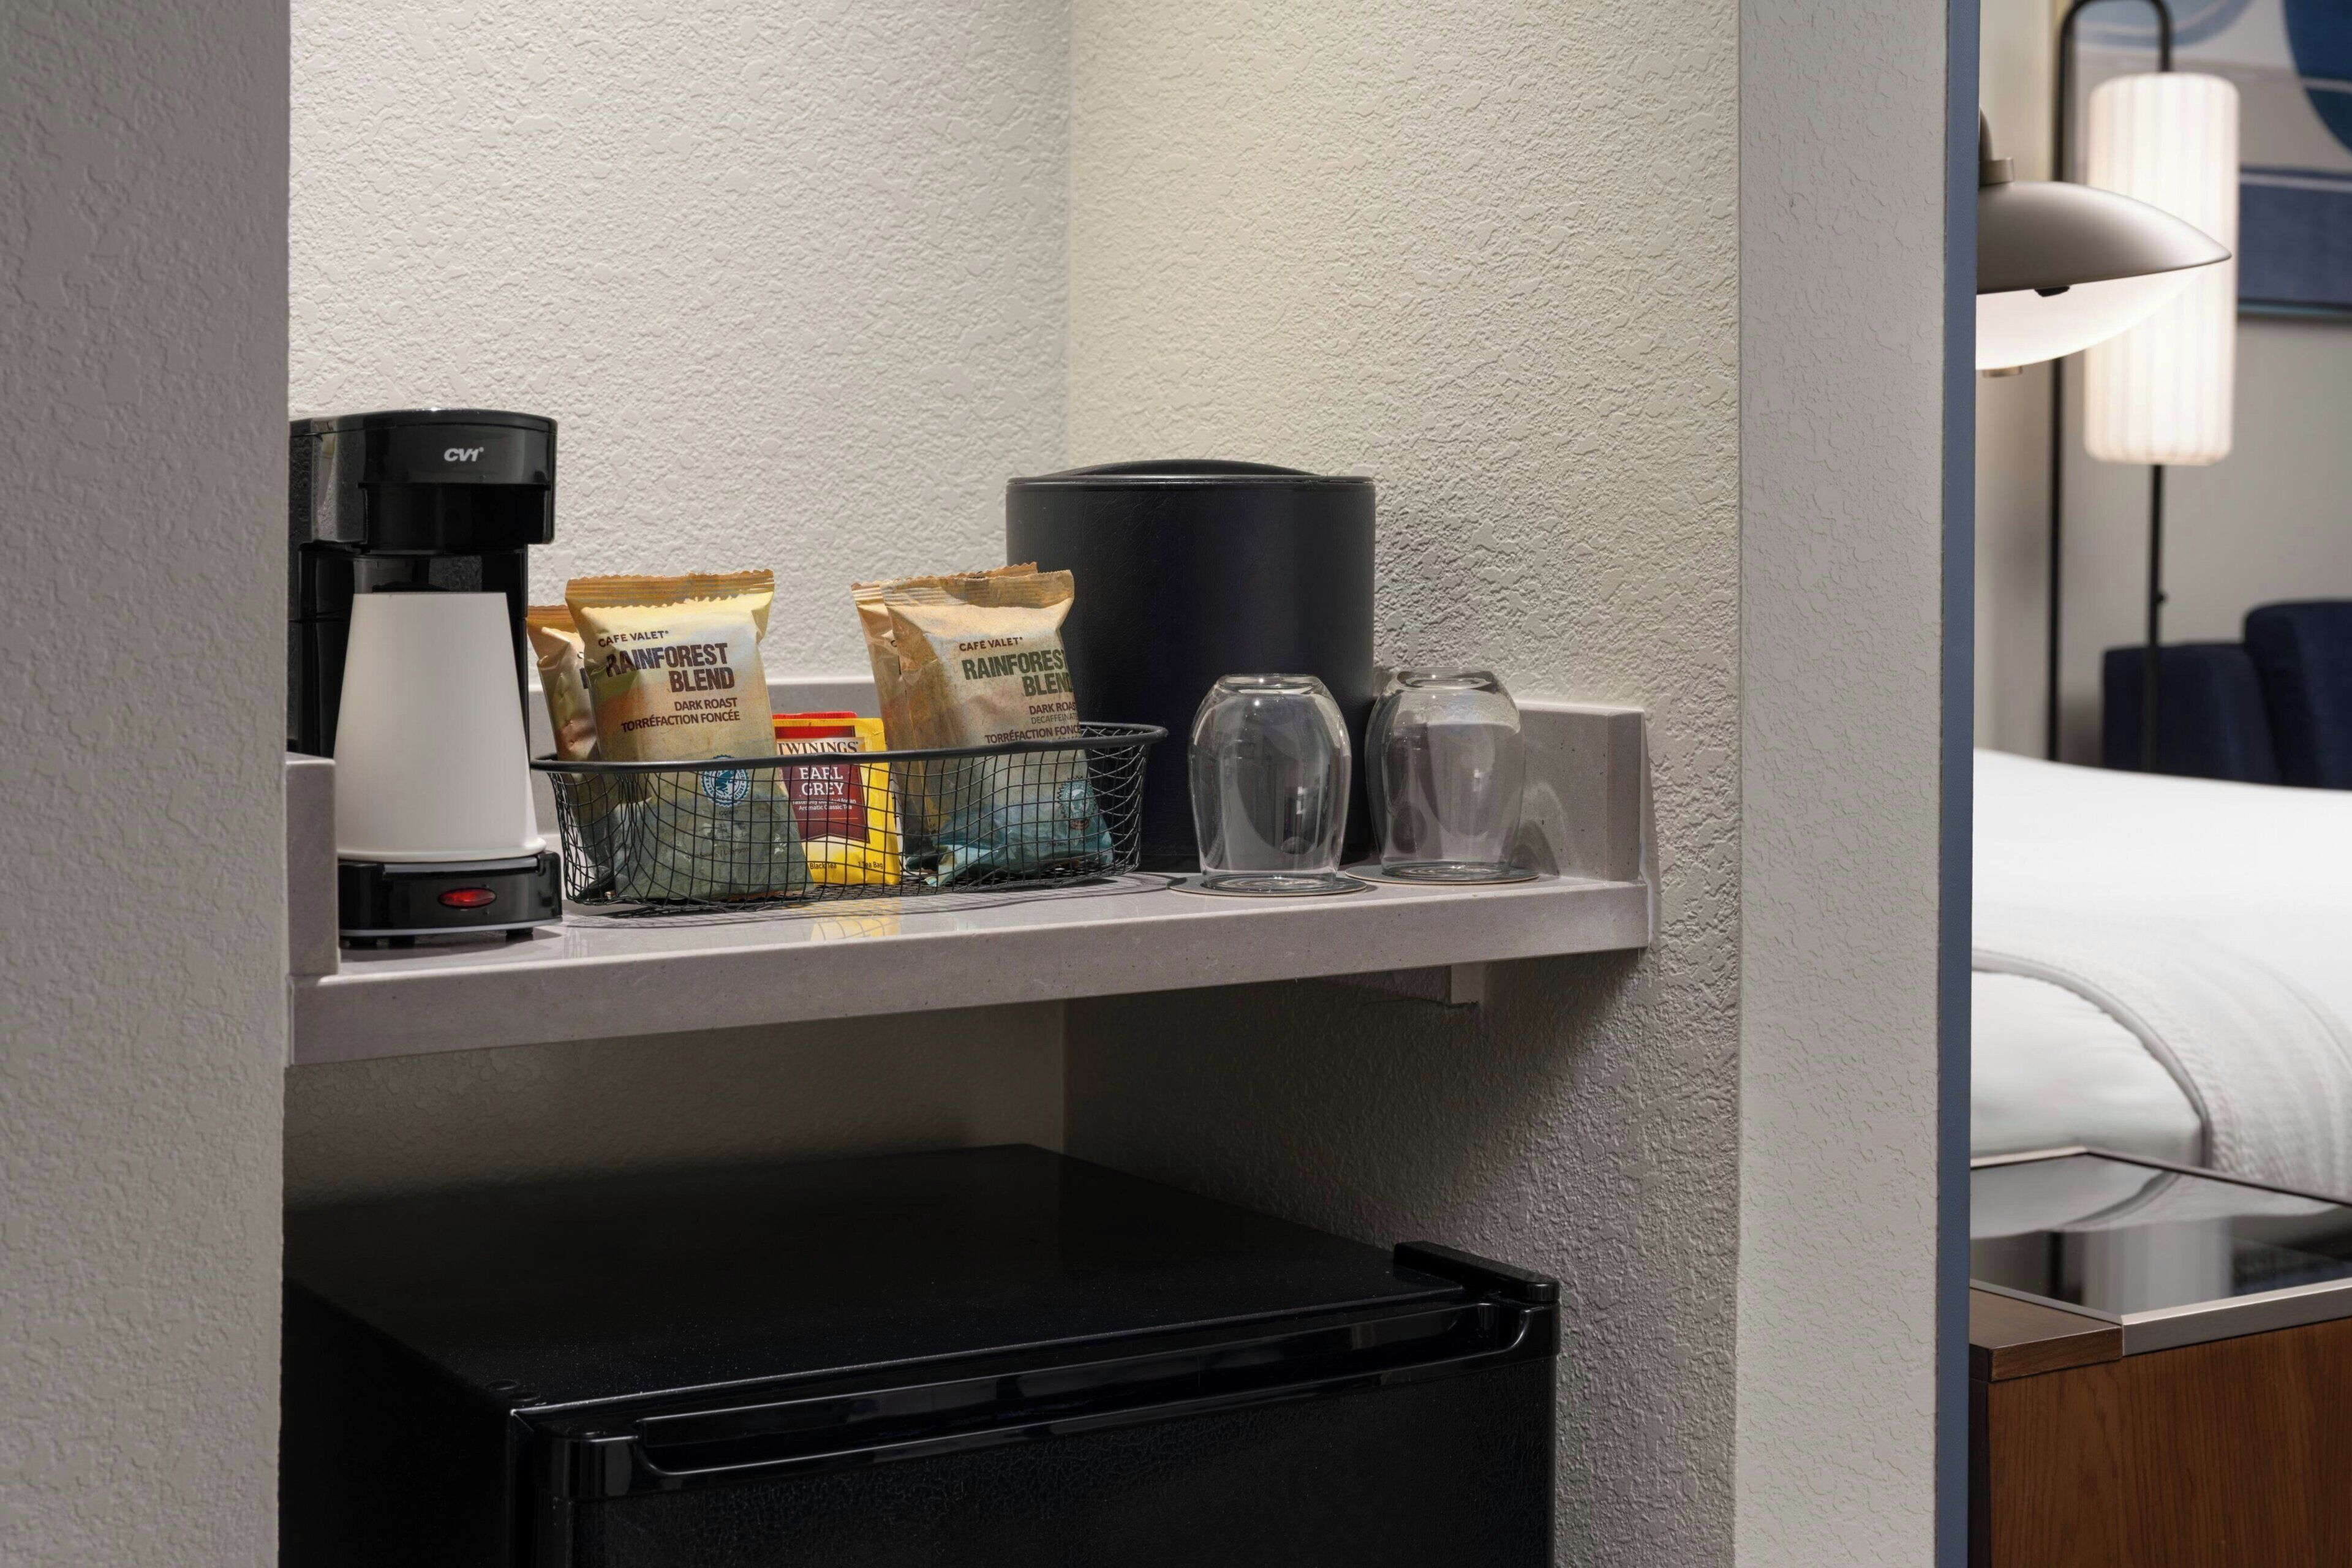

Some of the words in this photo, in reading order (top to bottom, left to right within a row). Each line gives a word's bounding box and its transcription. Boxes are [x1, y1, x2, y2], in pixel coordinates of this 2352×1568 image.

[606, 643, 728, 677] RAINFOREST
[668, 666, 735, 693] BLEND
[674, 700, 703, 712] DARK
[705, 697, 738, 709] ROAST
[1029, 703, 1055, 715] DARK
[621, 714, 699, 733] TORRÉFACTION
[701, 709, 741, 723] FONCÉE
[985, 727, 1053, 744] TORRÉFACTION
[777, 742, 858, 755] TWININGS
[799, 767, 843, 780] EARL
[801, 782, 844, 796] GREY
[873, 861, 883, 870] Bag
